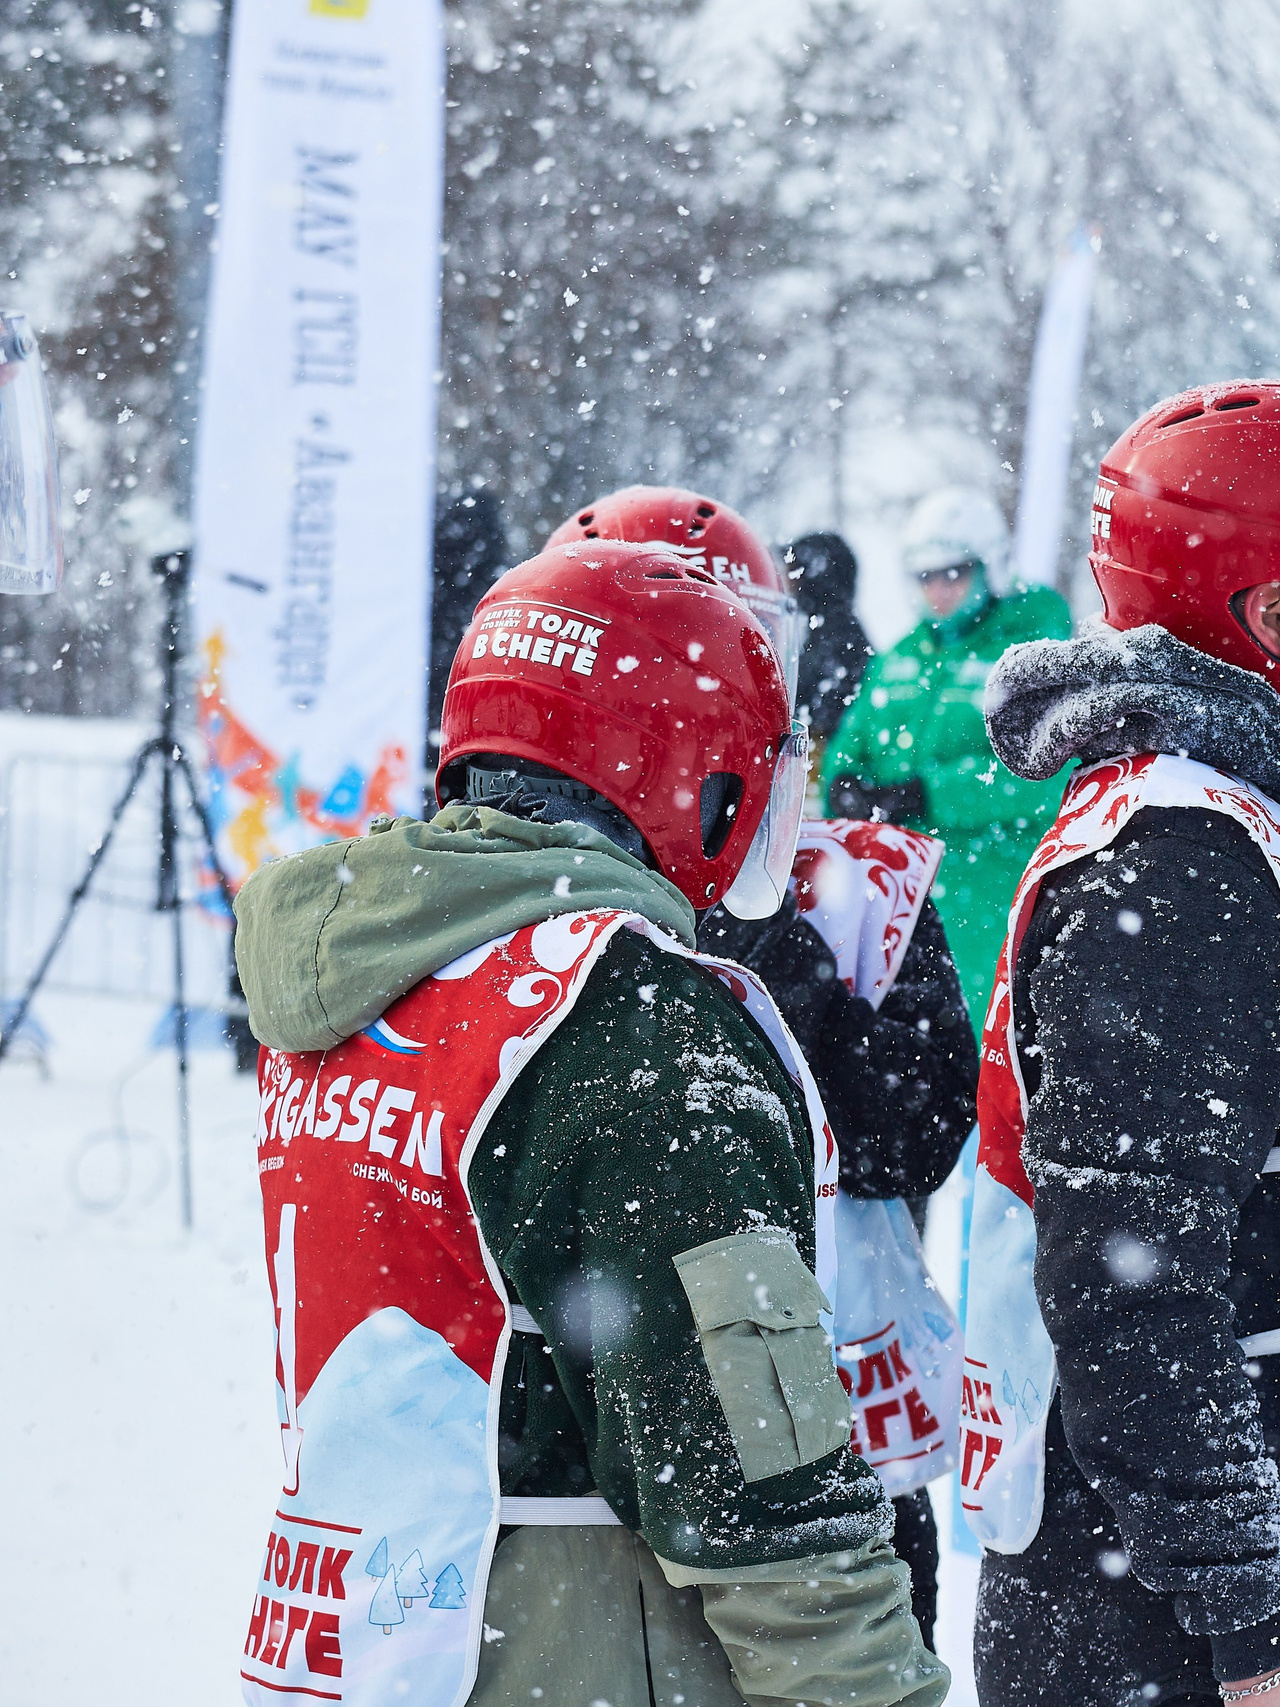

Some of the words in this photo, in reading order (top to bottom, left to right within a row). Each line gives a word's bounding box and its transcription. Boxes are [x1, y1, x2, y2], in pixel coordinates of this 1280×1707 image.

[527, 610, 605, 649] ТОЛК
[472, 633, 489, 659] В
[491, 632, 598, 677] СНЕГЕ
[411, 1187, 443, 1209] БОЙ
[263, 1532, 354, 1600] ТОЛК
